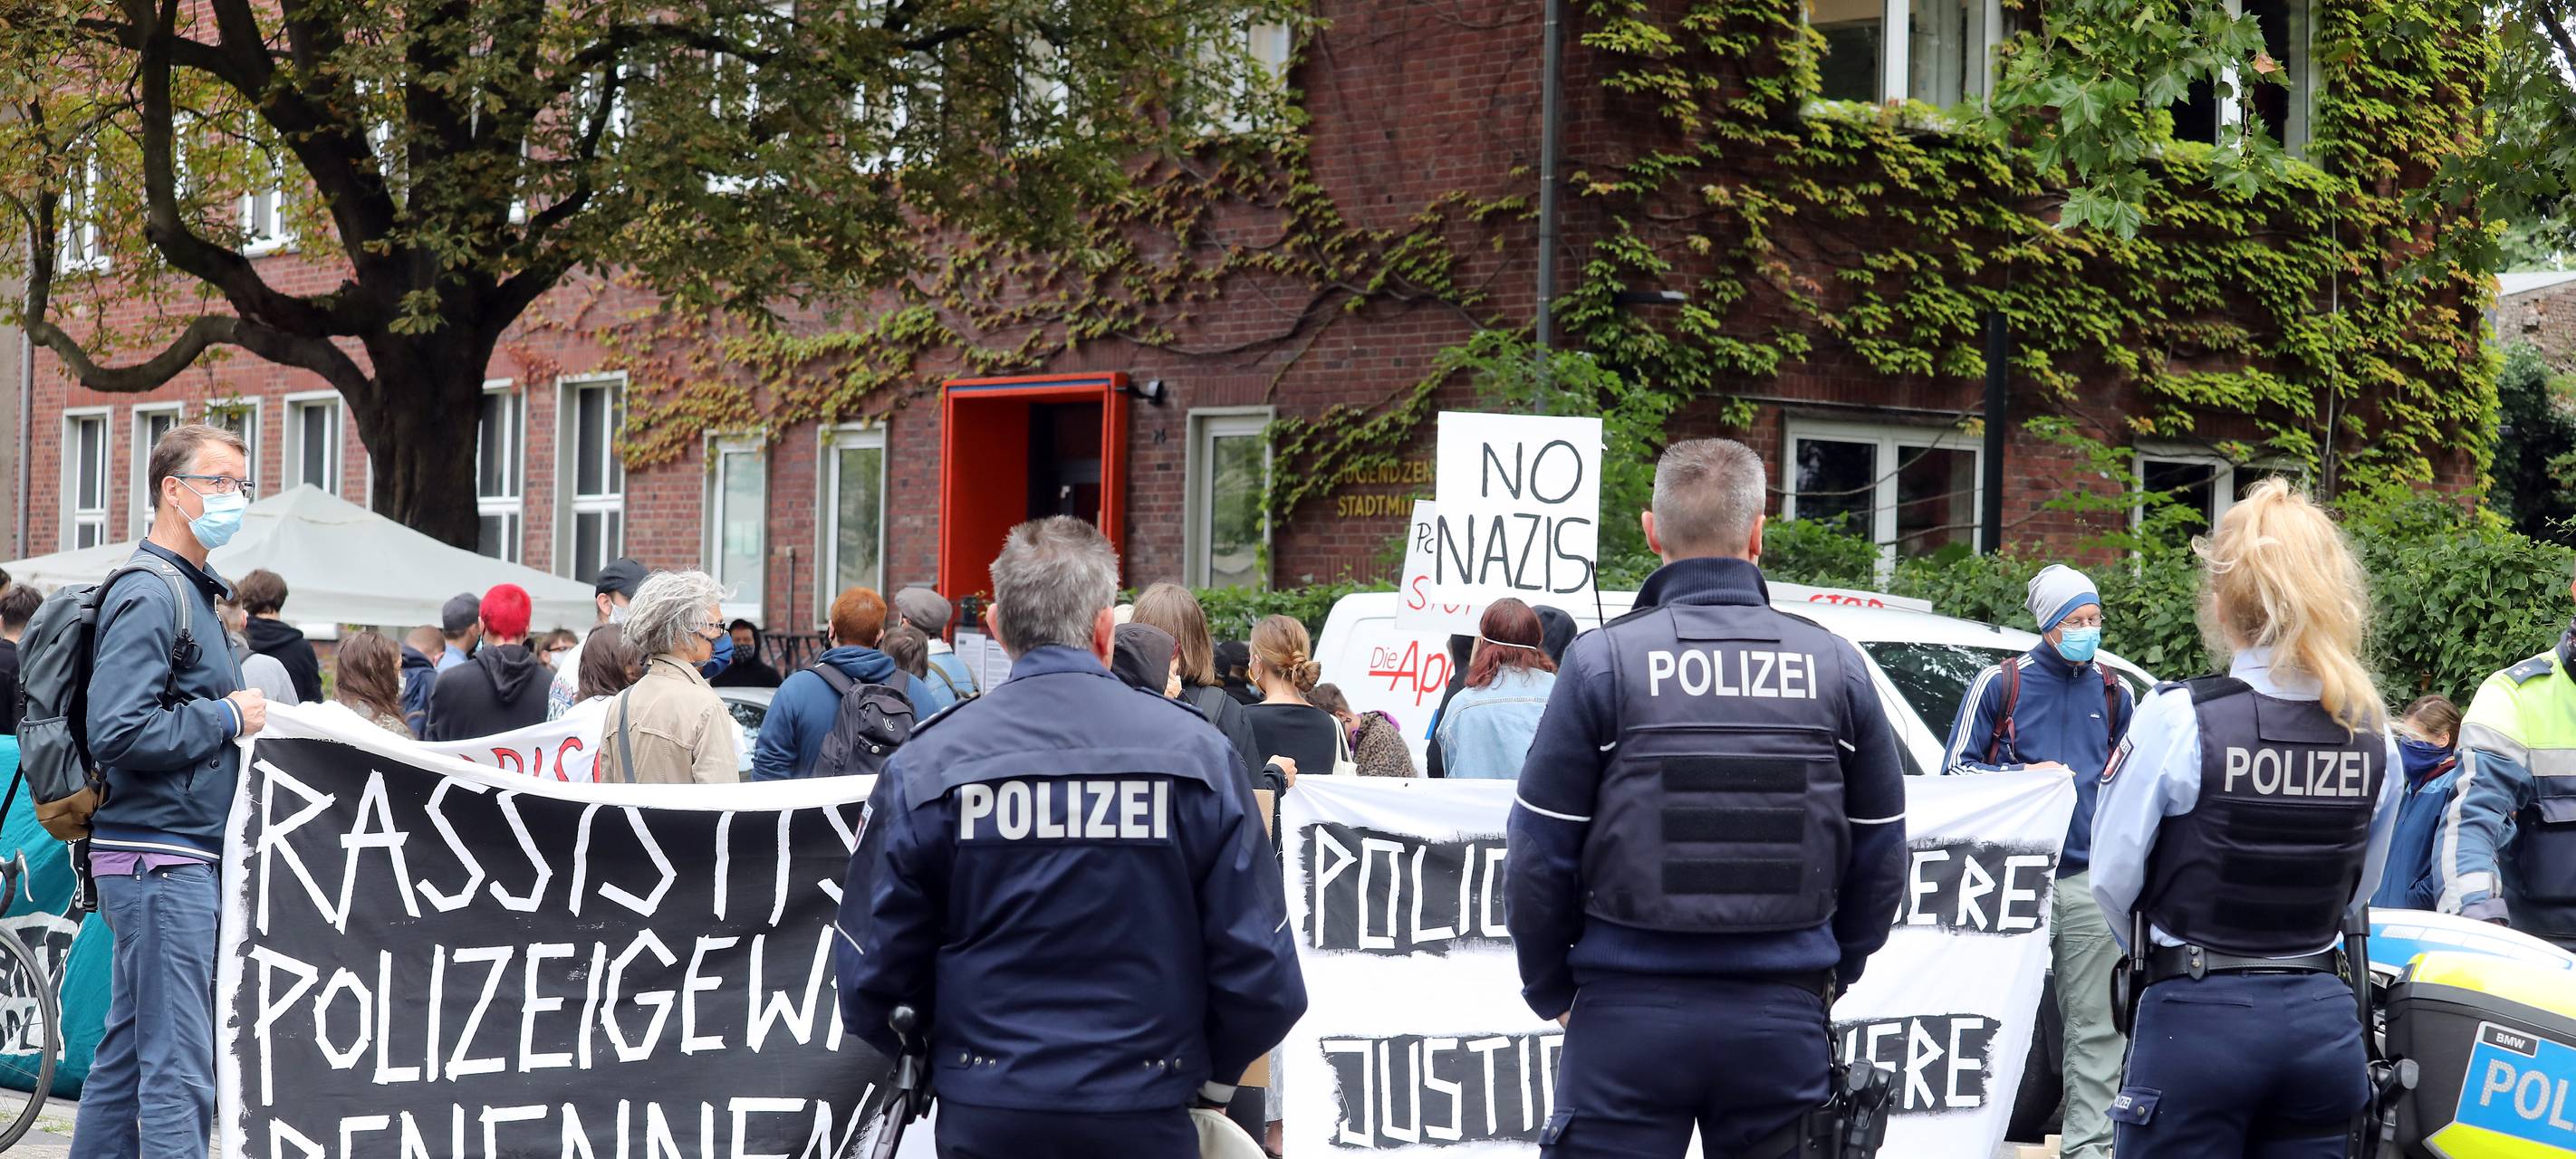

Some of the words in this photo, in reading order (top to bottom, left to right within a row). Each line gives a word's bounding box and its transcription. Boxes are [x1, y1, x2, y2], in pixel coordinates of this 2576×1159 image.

[1482, 439, 1583, 504] NO
[1437, 512, 1591, 594] NAZIS
[1370, 647, 1398, 669] Die
[1648, 649, 1817, 699] POLIZEI
[2225, 746, 2370, 797] POLIZEI
[960, 781, 1168, 840] POLIZEI
[248, 924, 846, 1106] POLIZEIGEW
[2495, 1032, 2525, 1049] BMW
[2479, 1058, 2576, 1132] POL
